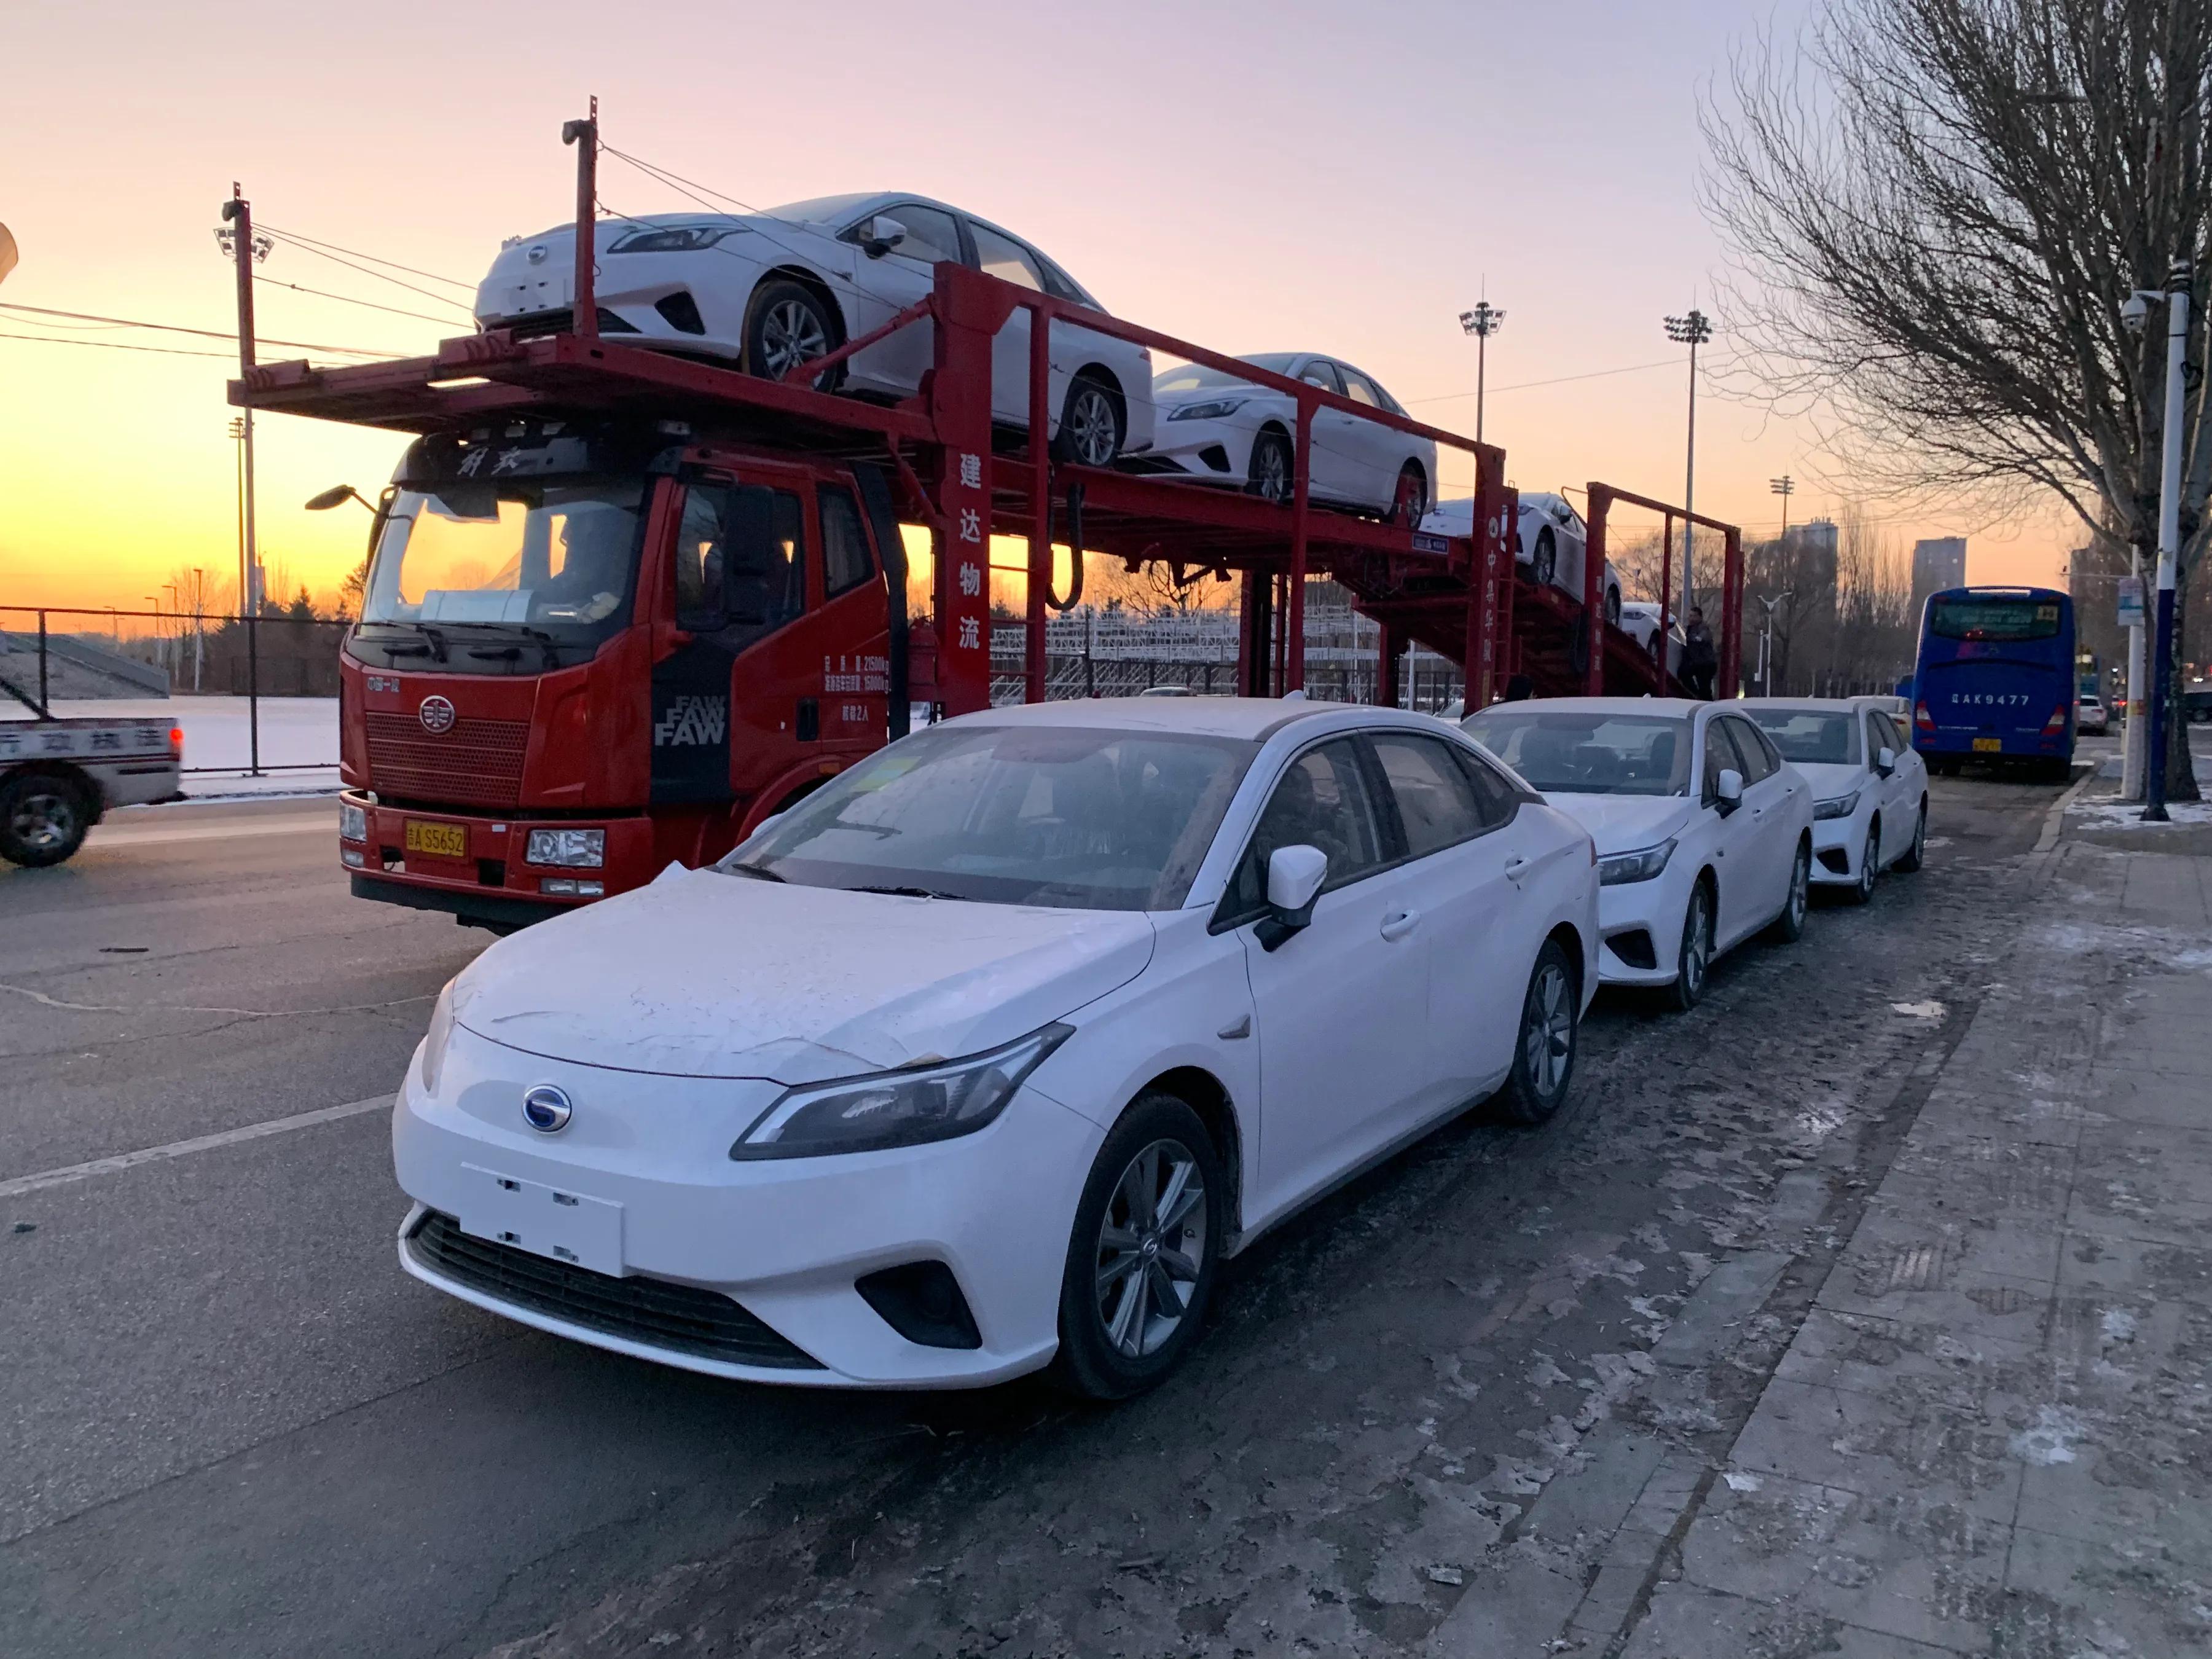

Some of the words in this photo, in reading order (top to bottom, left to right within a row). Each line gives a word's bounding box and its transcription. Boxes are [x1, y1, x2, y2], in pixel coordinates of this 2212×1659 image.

[959, 453, 981, 649] 建达物流
[677, 696, 725, 710] FAW
[666, 708, 725, 725] FAW
[655, 723, 725, 746] FAW
[408, 828, 463, 852] 吉AS5652
